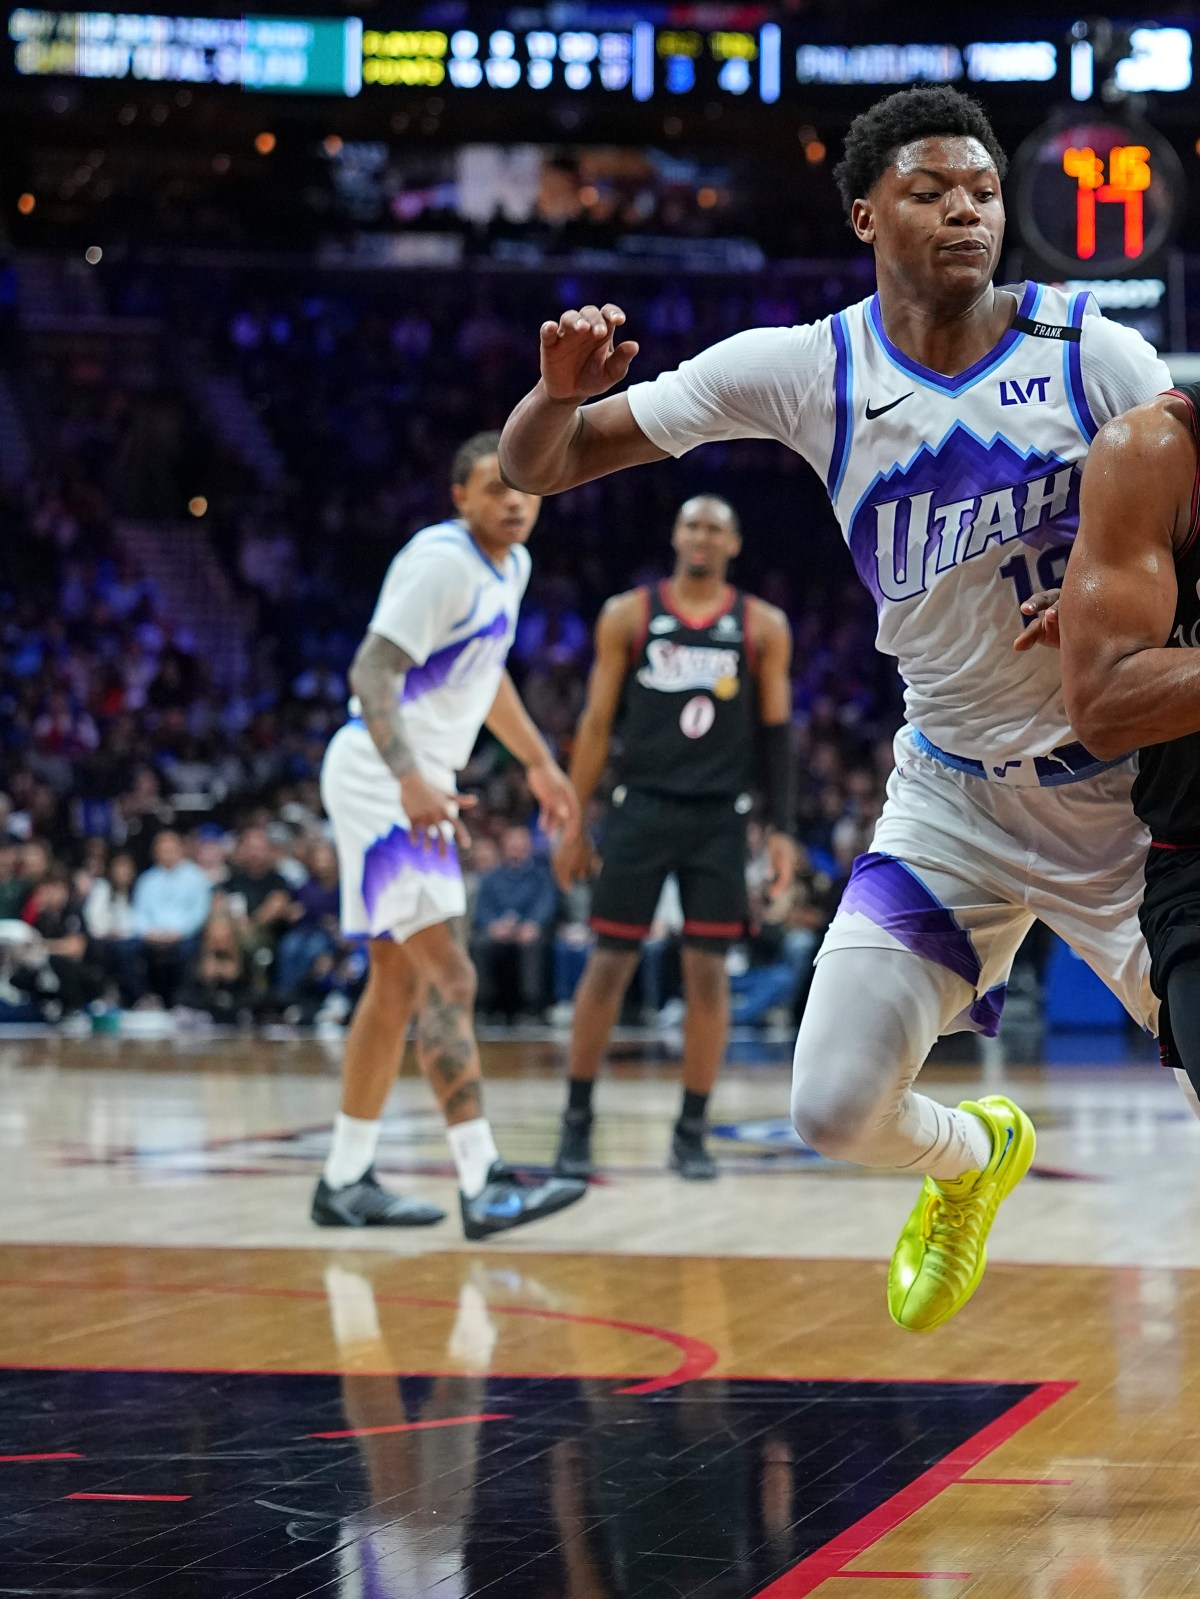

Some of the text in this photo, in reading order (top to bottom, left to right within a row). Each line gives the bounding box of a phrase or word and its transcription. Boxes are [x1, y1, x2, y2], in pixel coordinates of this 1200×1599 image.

[1033, 324, 1063, 338] FRANK
[999, 376, 1051, 406] LVT
[871, 462, 1078, 602] UTAH
[679, 695, 716, 739] 0
